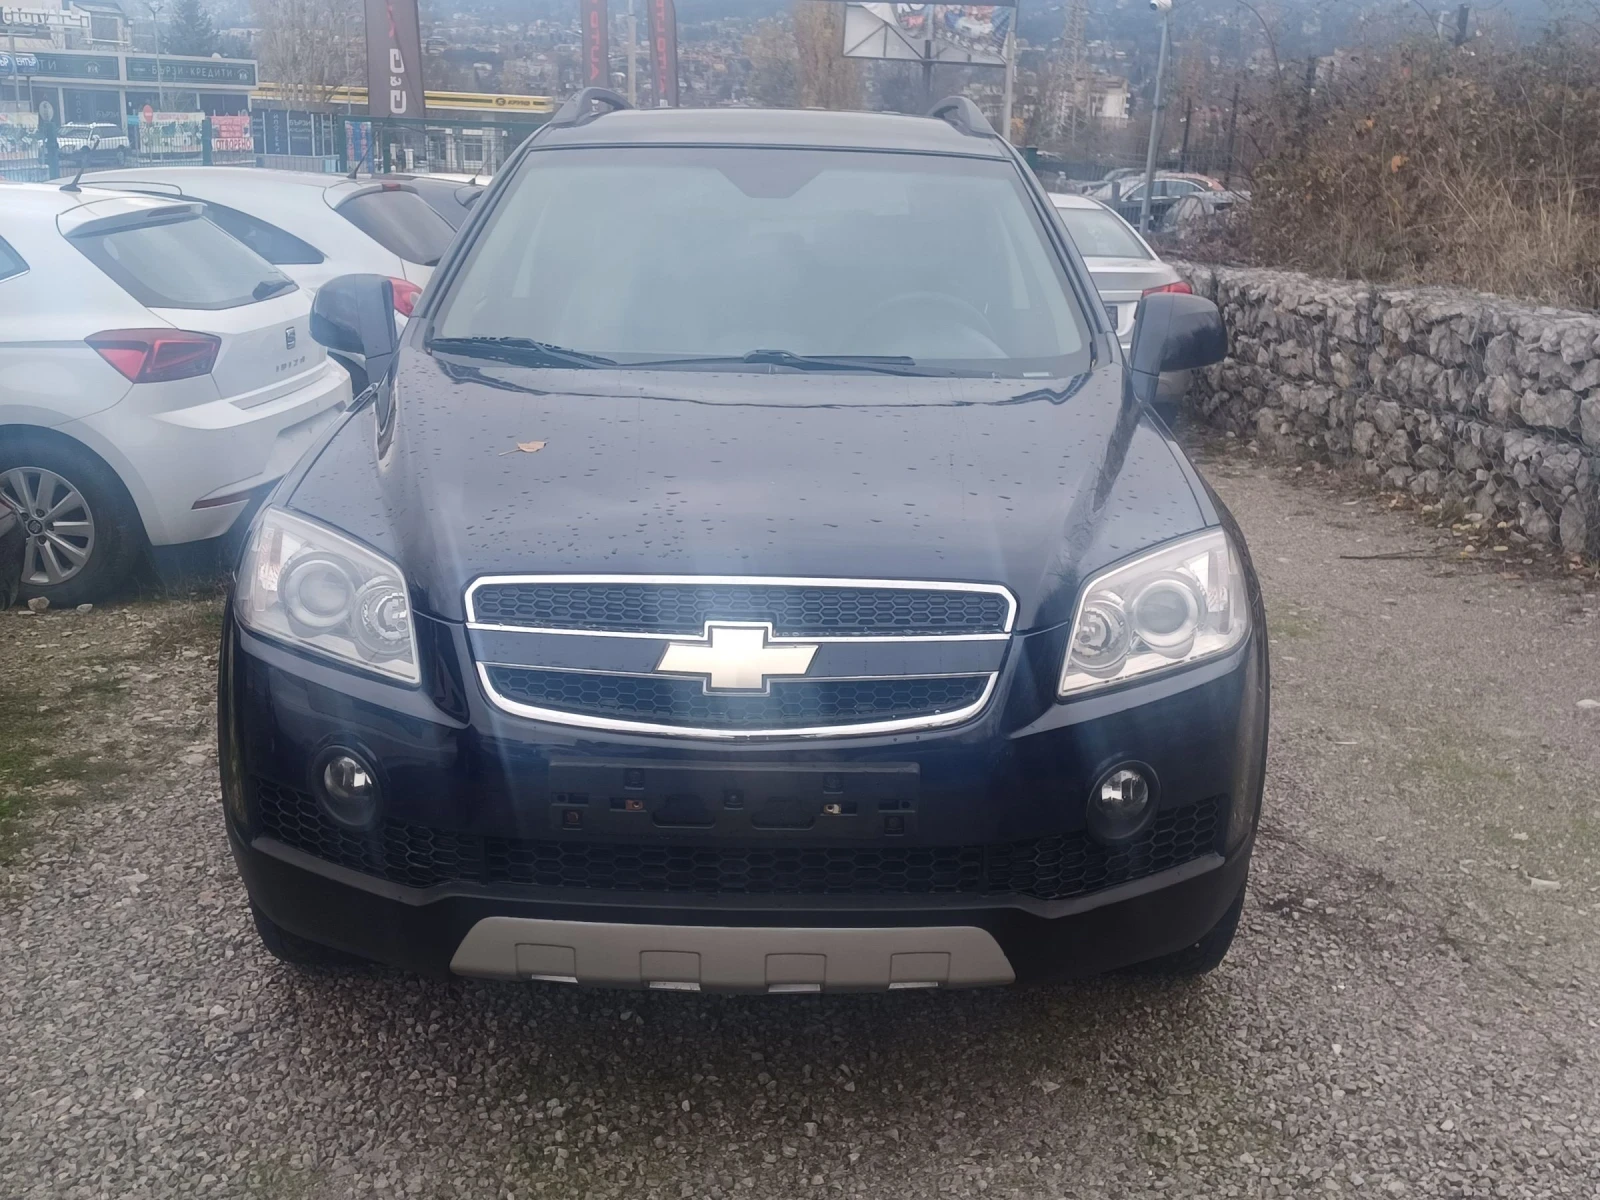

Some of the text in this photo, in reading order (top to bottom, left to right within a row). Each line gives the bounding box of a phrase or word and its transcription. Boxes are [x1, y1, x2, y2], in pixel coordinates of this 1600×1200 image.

[151, 65, 183, 76] БЪРЗИ
[190, 68, 233, 78] КРЕДИТИ
[275, 356, 306, 372] IBIZA
